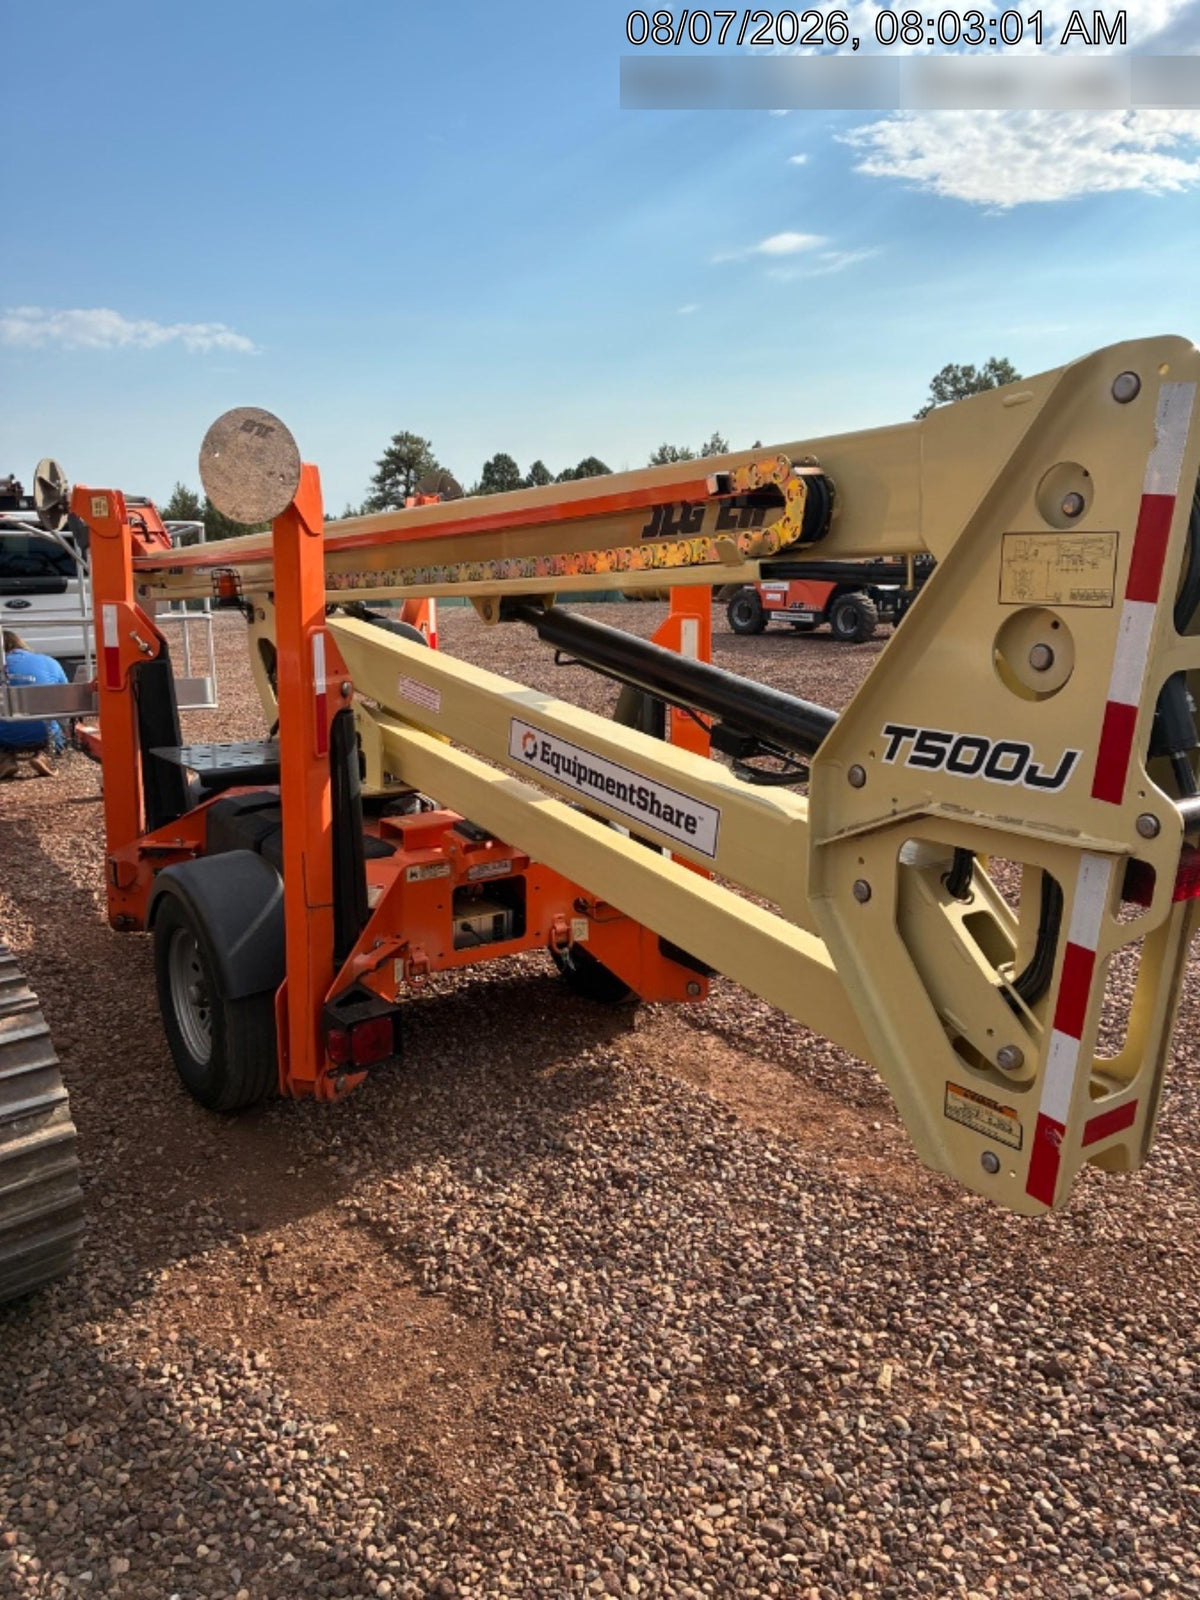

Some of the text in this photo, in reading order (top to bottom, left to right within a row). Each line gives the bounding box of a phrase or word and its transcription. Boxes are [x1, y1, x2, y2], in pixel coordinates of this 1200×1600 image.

[641, 500, 707, 539] JLG
[540, 740, 698, 835] EquipmentShare
[882, 723, 1081, 791] T500J
